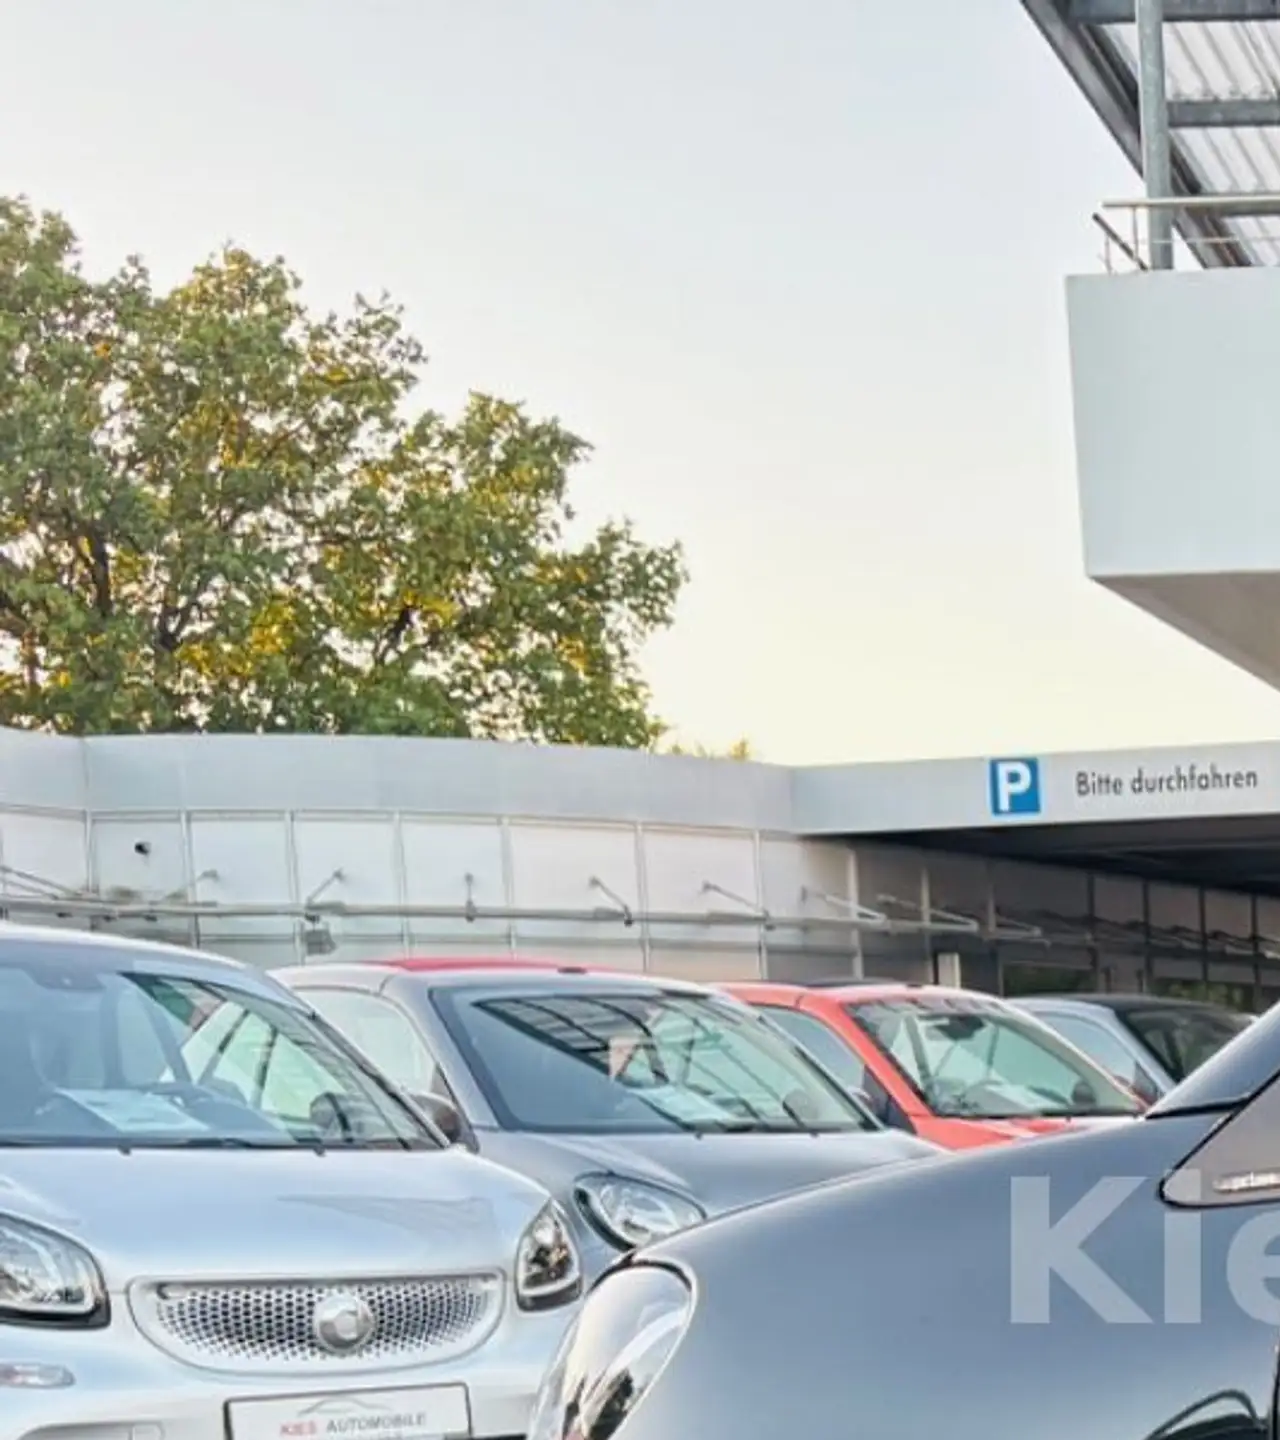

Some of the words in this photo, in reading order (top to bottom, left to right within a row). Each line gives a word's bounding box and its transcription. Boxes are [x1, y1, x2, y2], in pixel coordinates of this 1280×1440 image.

[997, 761, 1031, 812] P
[1075, 771, 1123, 796] Bitte
[1130, 767, 1258, 795] durchfahren
[280, 1421, 317, 1436] KIES
[326, 1412, 428, 1434] AUTOMOBILE
